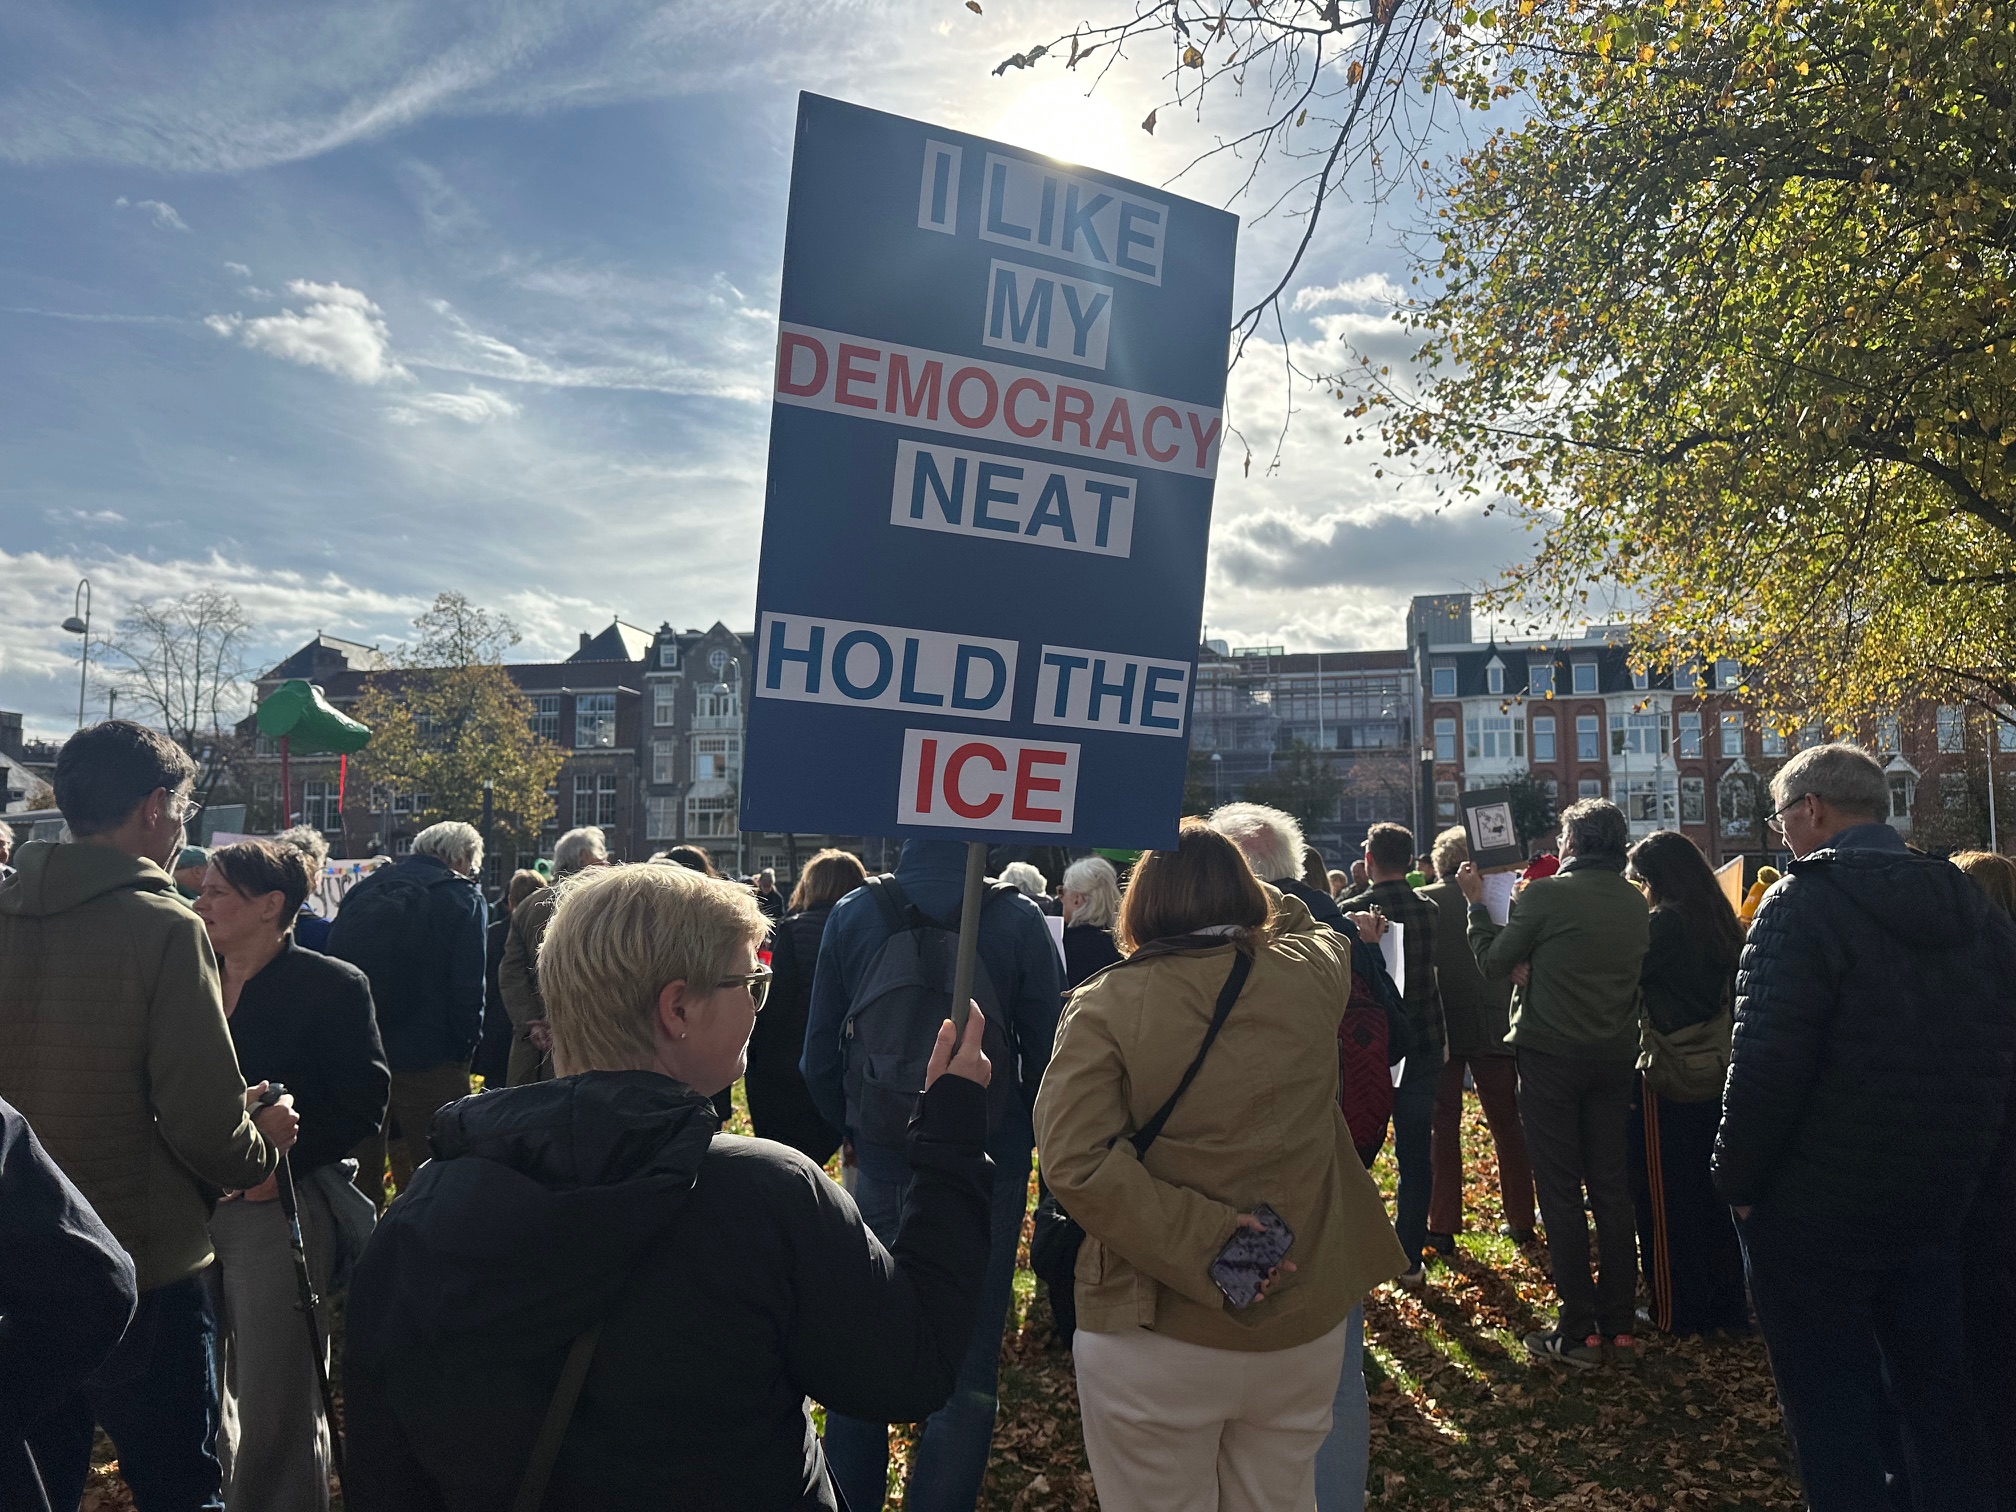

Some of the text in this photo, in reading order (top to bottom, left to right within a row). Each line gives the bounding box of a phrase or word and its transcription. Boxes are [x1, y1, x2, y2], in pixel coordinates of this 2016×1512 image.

[931, 152, 1160, 278] I LIKE
[990, 269, 1110, 358] MY
[777, 331, 1222, 469] DEMOCRACY
[909, 451, 1130, 547] NEAT
[766, 620, 1187, 730] HOLD THE
[915, 738, 1067, 823] ICE
